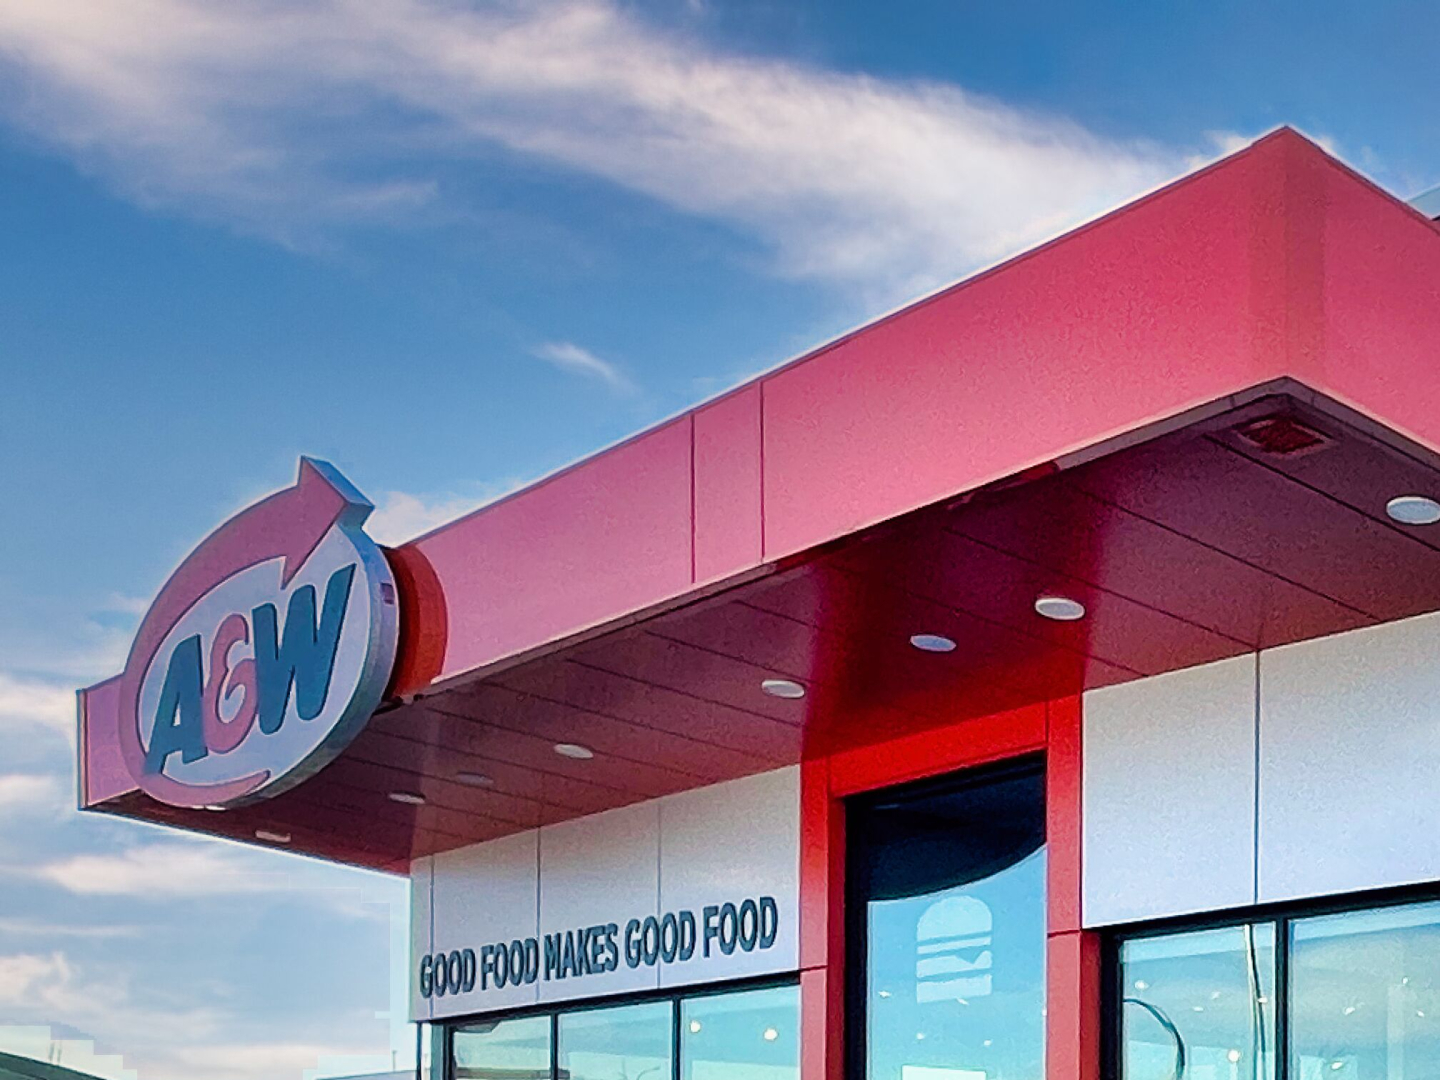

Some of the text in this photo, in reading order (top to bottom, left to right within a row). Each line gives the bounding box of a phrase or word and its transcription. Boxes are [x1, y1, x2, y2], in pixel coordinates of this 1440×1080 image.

[145, 563, 357, 775] A&W
[419, 896, 778, 999] GOOD FOOD MAKES GOOD FOOD
